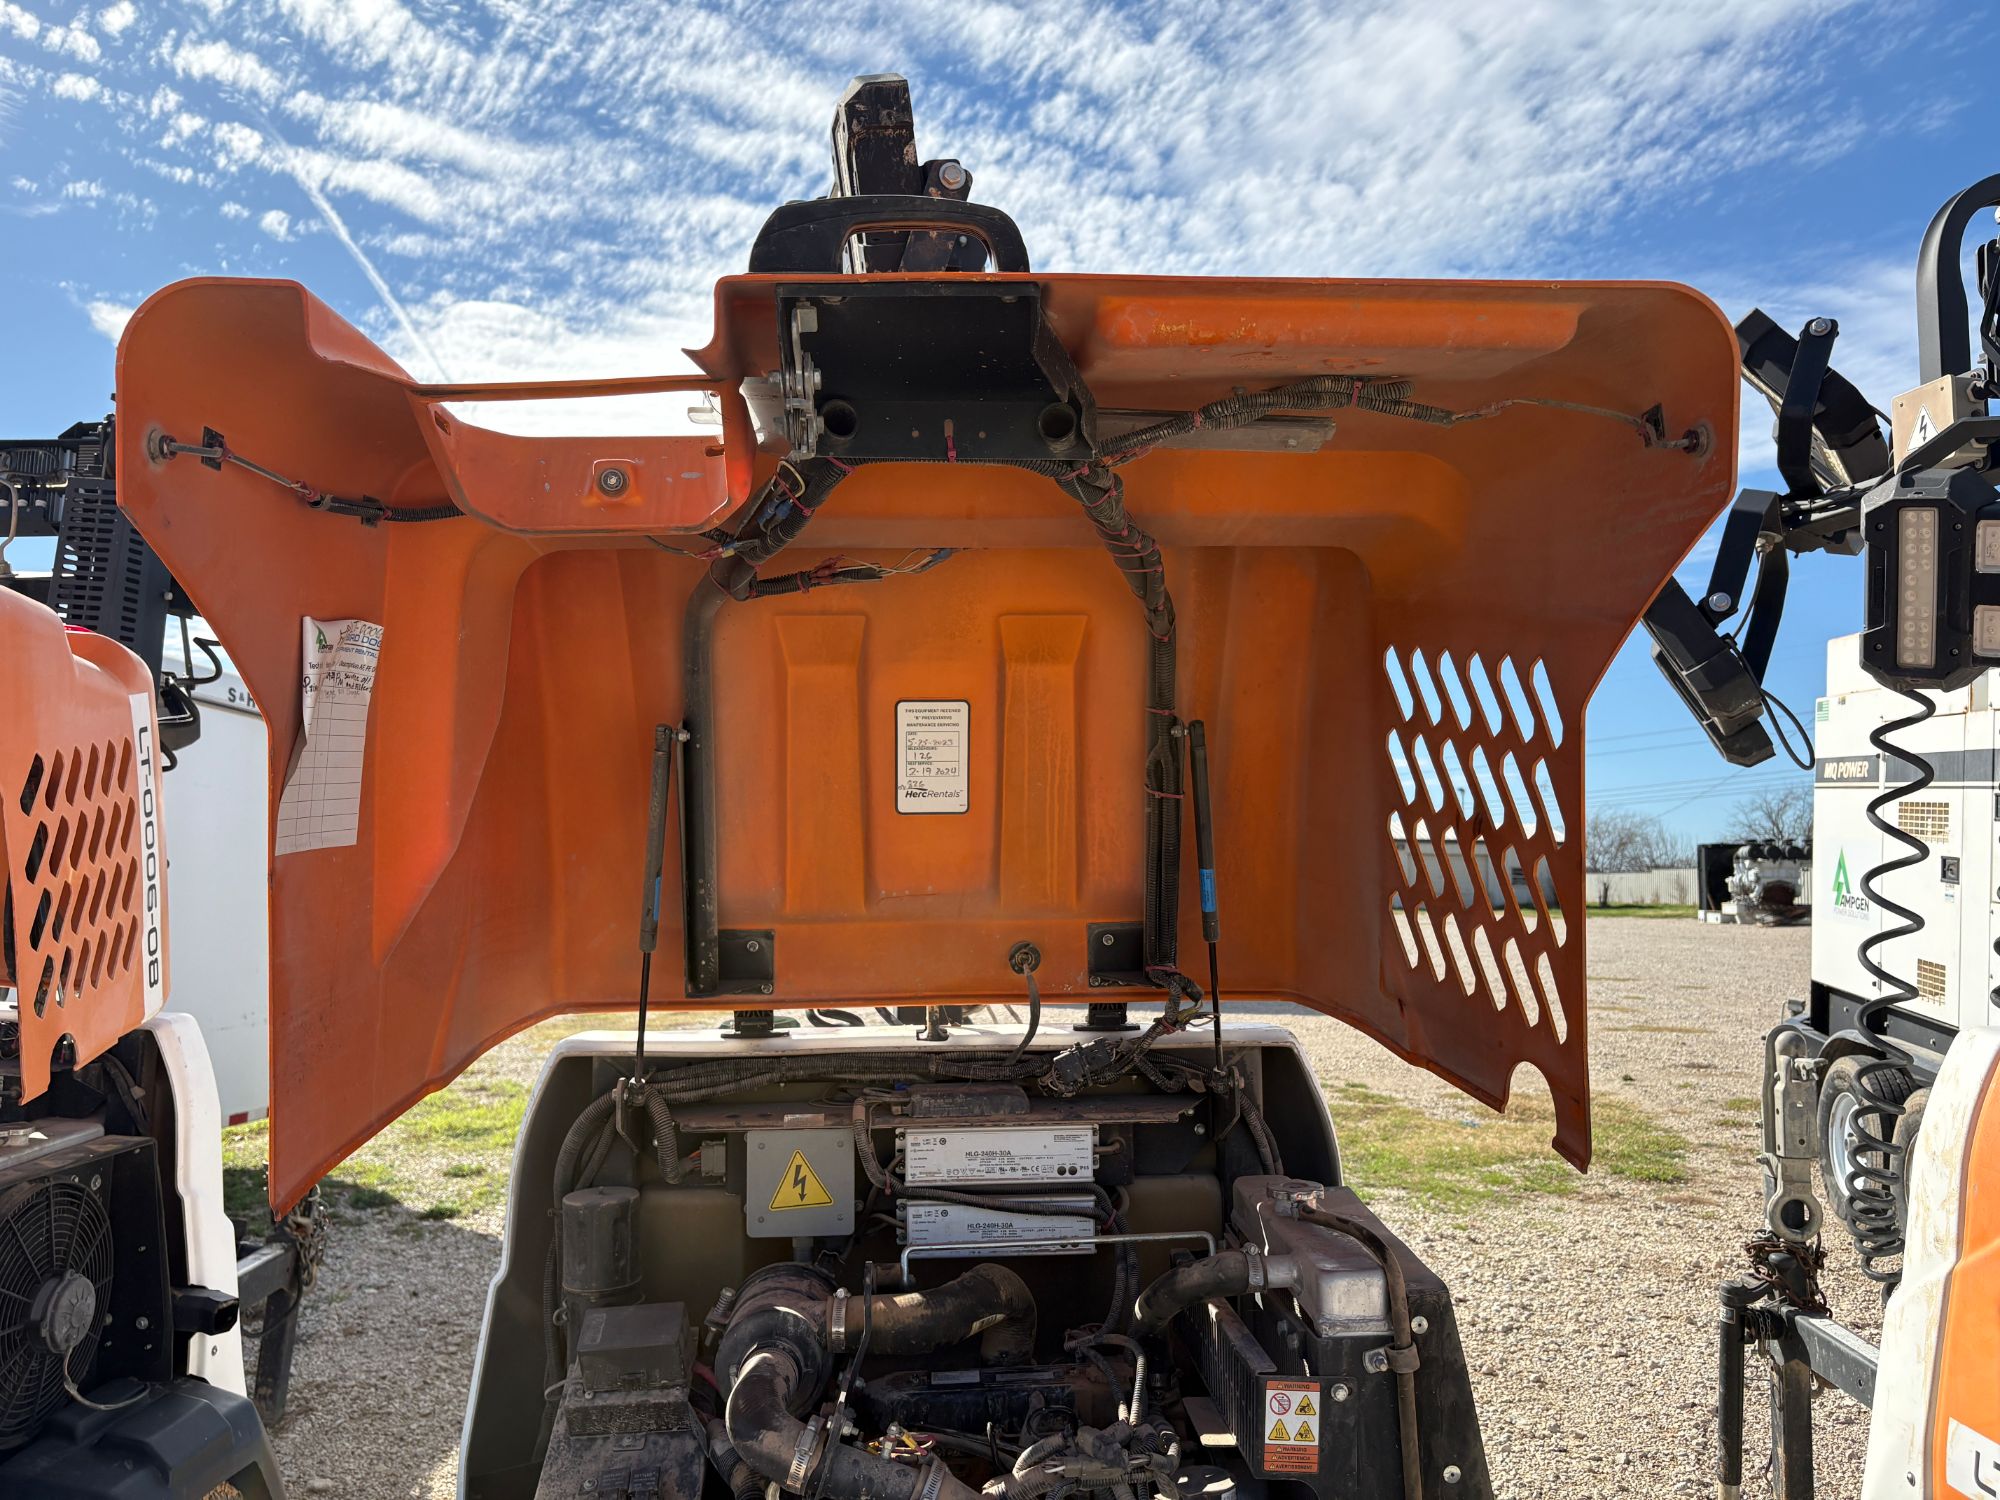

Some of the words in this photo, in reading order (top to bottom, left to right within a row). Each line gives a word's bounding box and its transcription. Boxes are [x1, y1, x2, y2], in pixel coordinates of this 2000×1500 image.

[1823, 762, 1838, 780] MQ
[1837, 761, 1869, 778] POWER
[138, 726, 160, 989] LT-0006-08
[1839, 894, 1870, 912] AMPGEN
[1974, 1450, 2000, 1498] L
